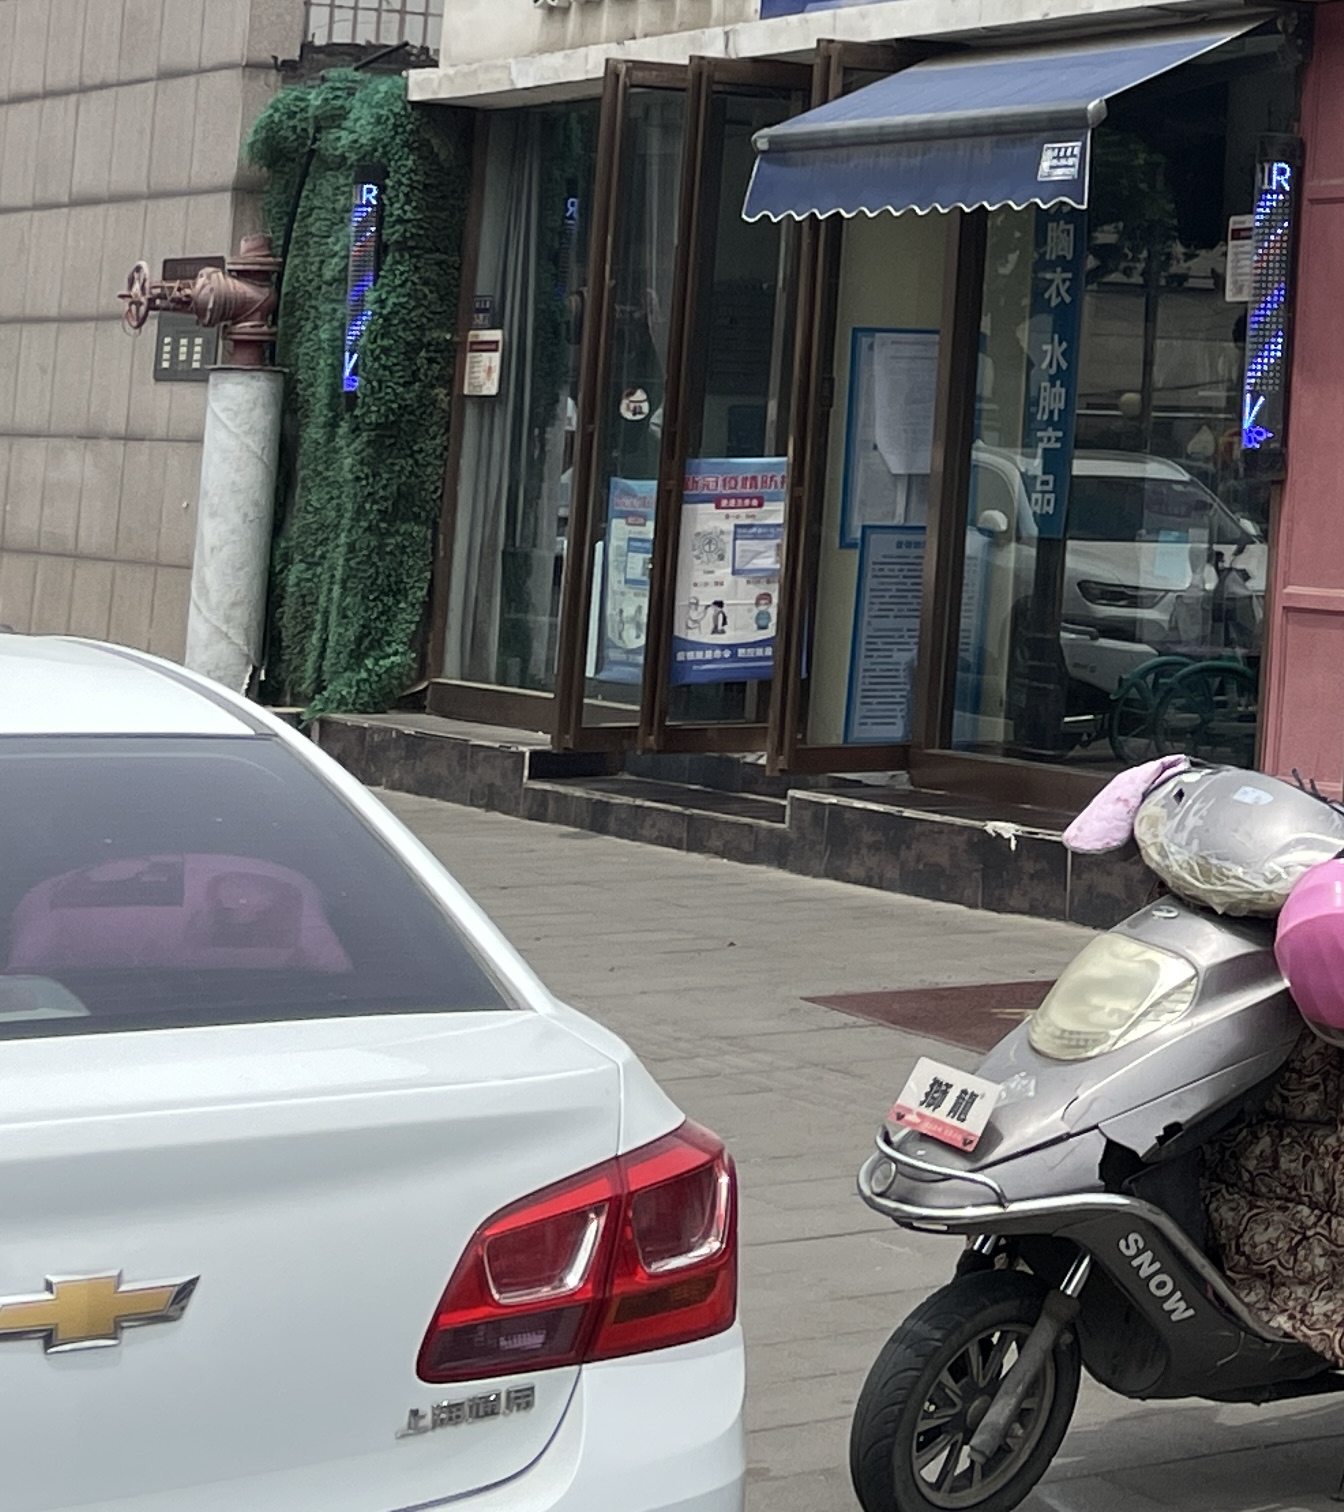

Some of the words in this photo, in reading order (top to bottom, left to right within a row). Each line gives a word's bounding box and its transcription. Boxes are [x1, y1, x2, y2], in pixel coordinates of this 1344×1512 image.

[1044, 204, 1075, 309] 胸衣
[1118, 1232, 1196, 1324] SNOW
[395, 1384, 535, 1439] 上海通用
